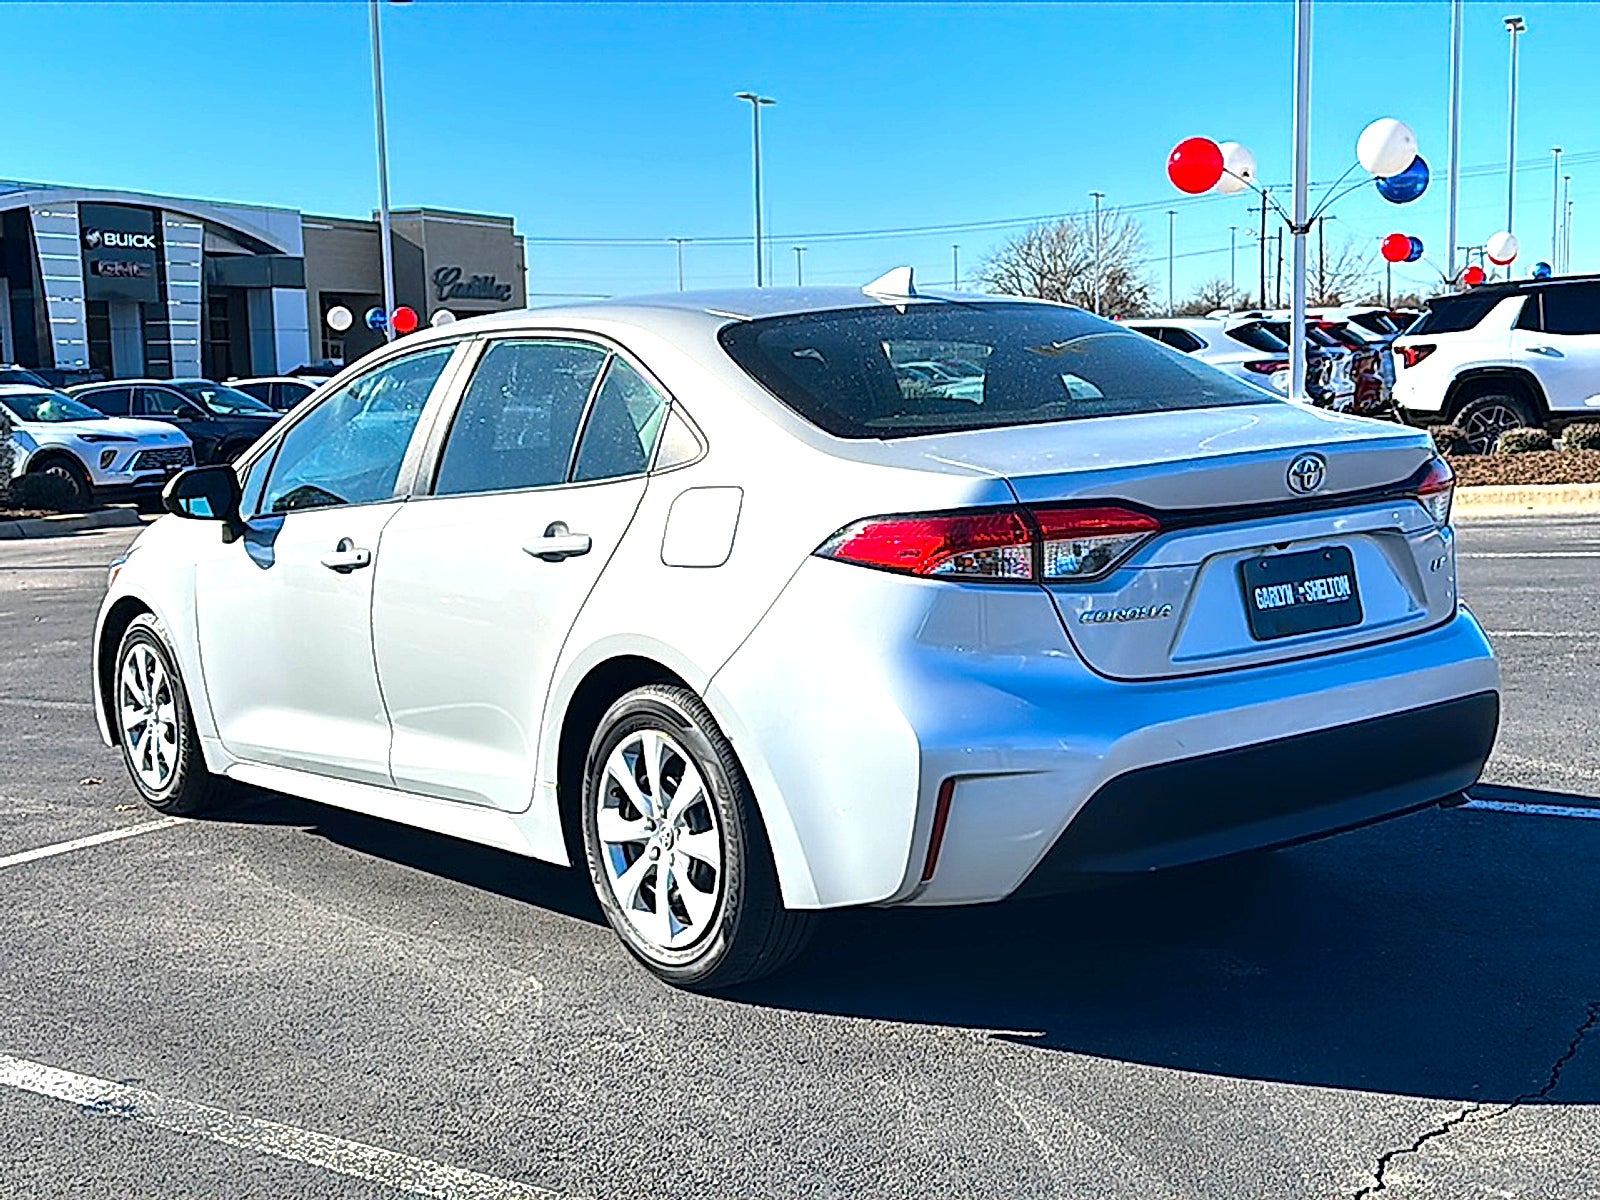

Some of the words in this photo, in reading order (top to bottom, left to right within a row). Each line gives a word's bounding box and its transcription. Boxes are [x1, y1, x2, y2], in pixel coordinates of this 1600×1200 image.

[103, 232, 156, 249] BUICK
[1254, 583, 1295, 609] GARLYN
[1303, 574, 1351, 602] SHELTON
[1079, 603, 1173, 624] COROLLA
